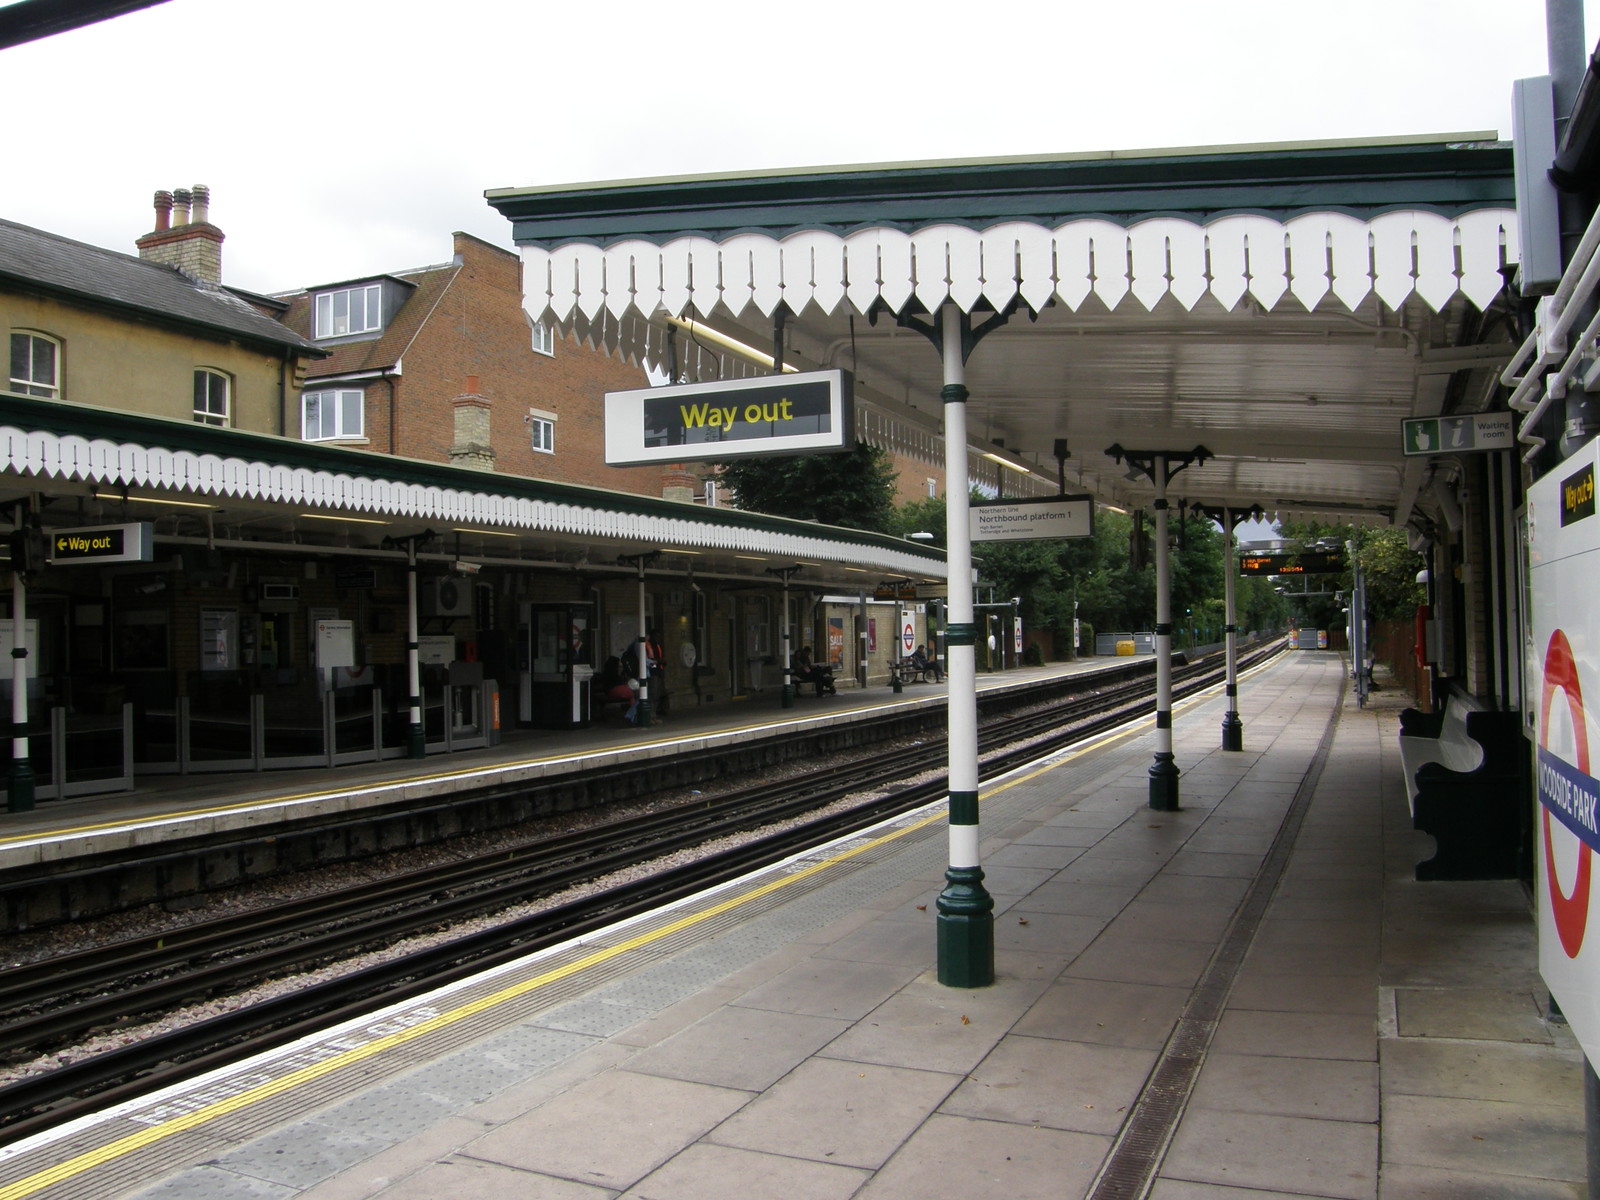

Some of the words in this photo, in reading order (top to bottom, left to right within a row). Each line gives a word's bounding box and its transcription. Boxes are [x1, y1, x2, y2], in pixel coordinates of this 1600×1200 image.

[680, 402, 737, 432] Way
[744, 398, 793, 424] out
[1478, 421, 1510, 430] Waiting
[1483, 431, 1505, 439] room
[1565, 485, 1577, 513] Way
[1577, 479, 1588, 505] out
[979, 514, 1027, 523] Northbound
[1030, 512, 1065, 522] platform
[68, 536, 90, 552] Way
[92, 536, 111, 549] out
[829, 635, 843, 646] SALE
[1538, 760, 1572, 815] WOODSIDE
[1573, 784, 1598, 835] PARK
[129, 1073, 273, 1126] MIND
[265, 1036, 371, 1069] THE
